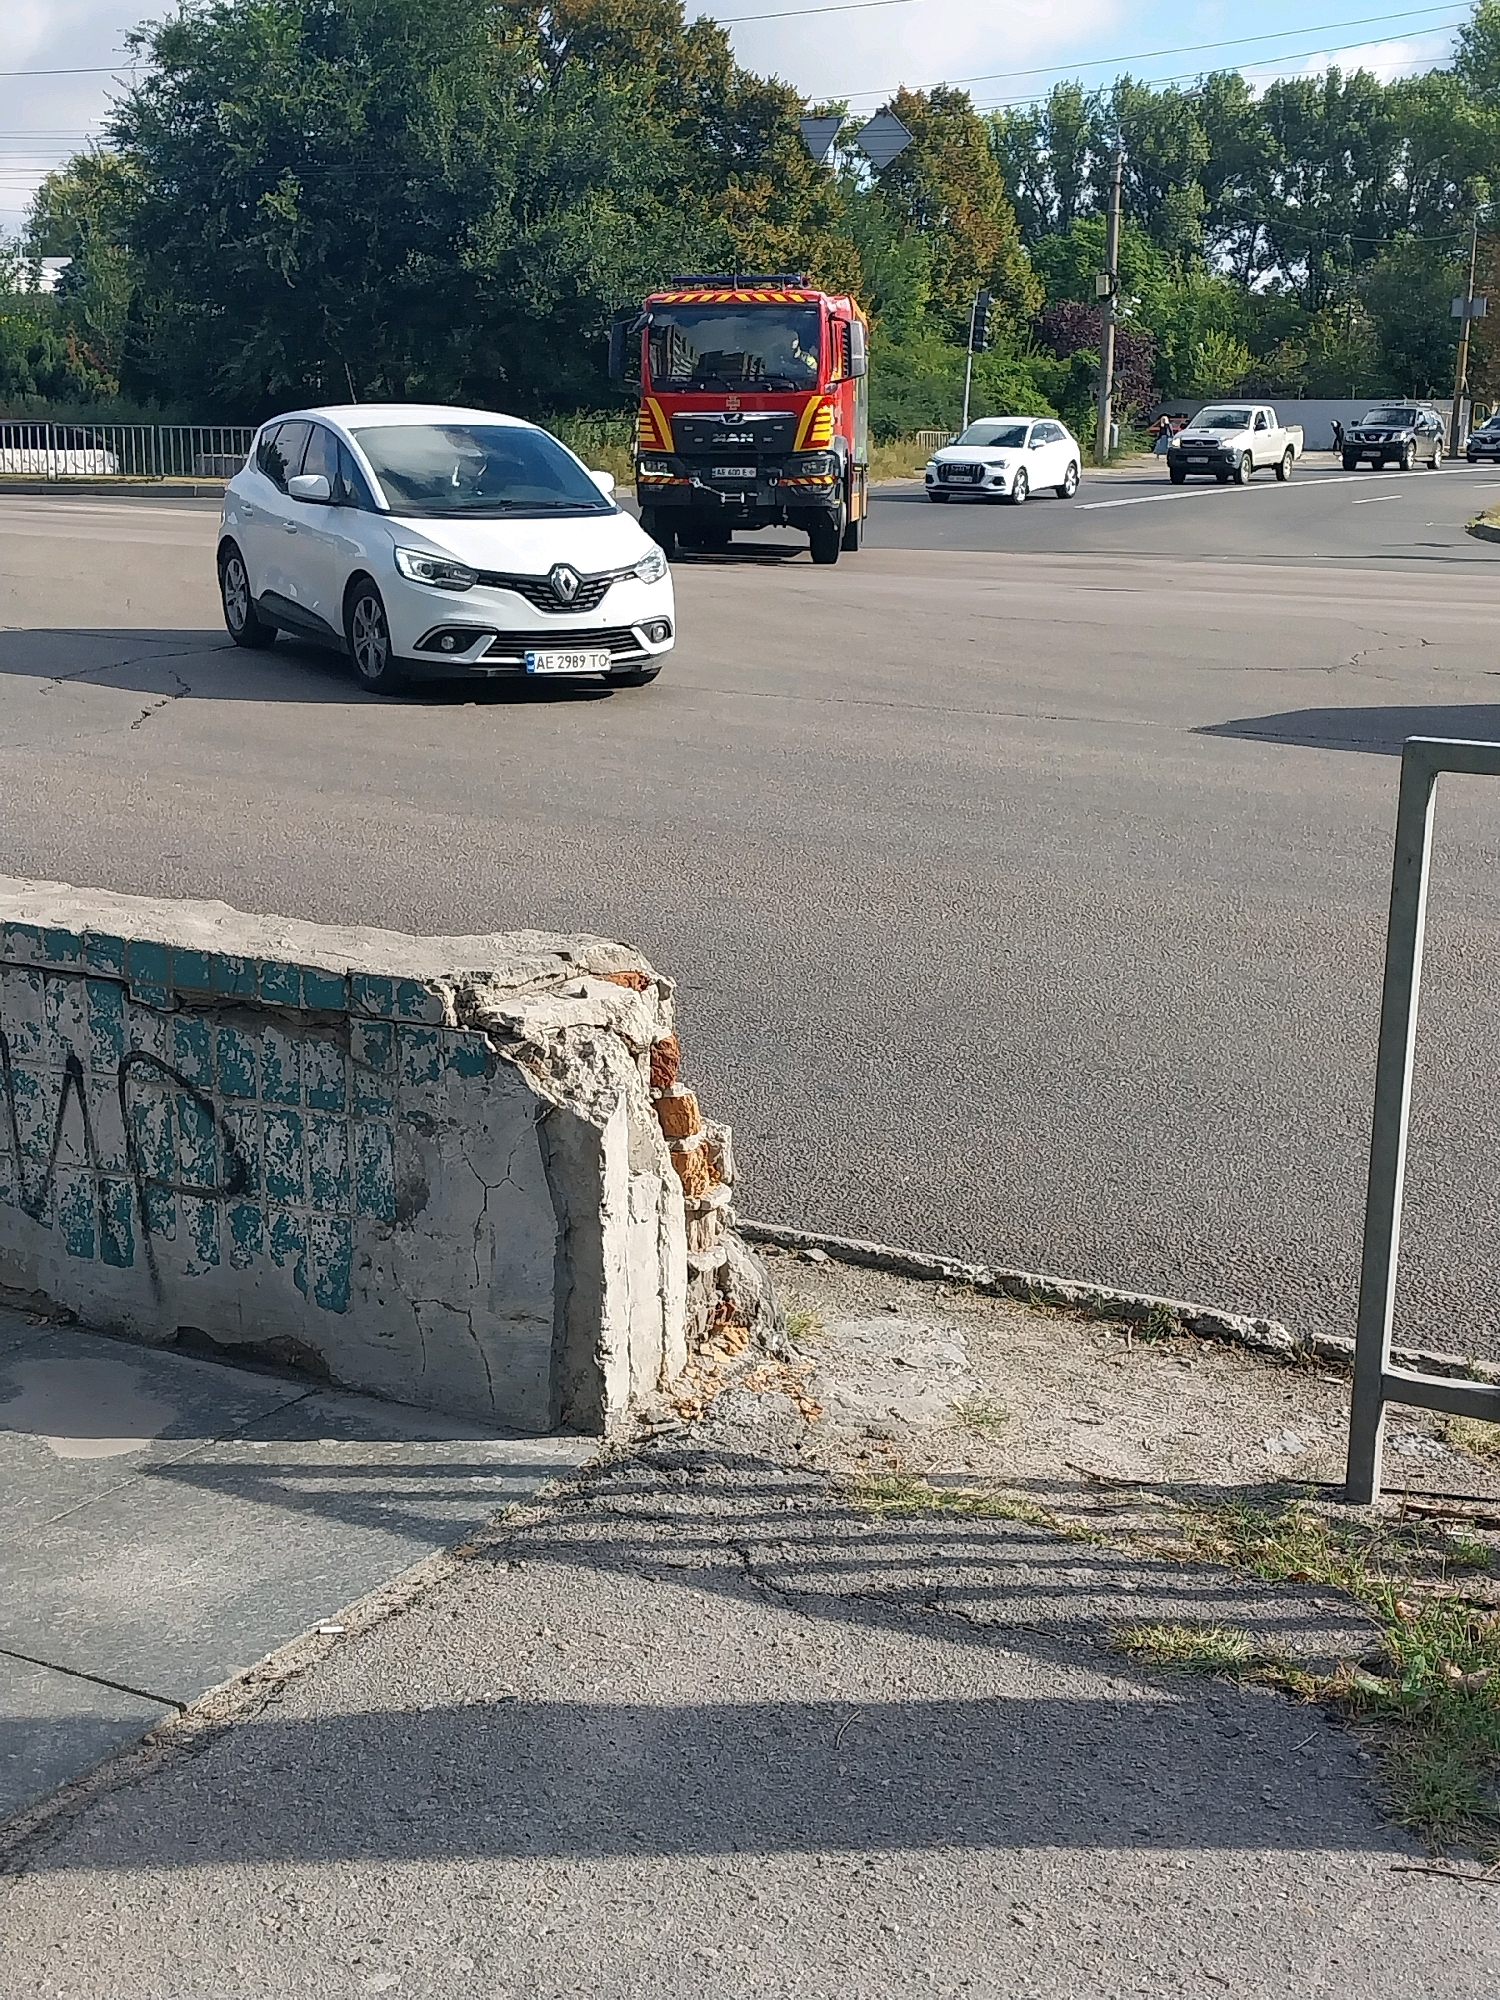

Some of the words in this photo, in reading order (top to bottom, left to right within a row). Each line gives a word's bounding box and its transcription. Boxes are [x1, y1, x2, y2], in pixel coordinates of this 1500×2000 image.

[536, 655, 555, 670] AE
[557, 654, 586, 669] 2989
[589, 653, 607, 668] TO
